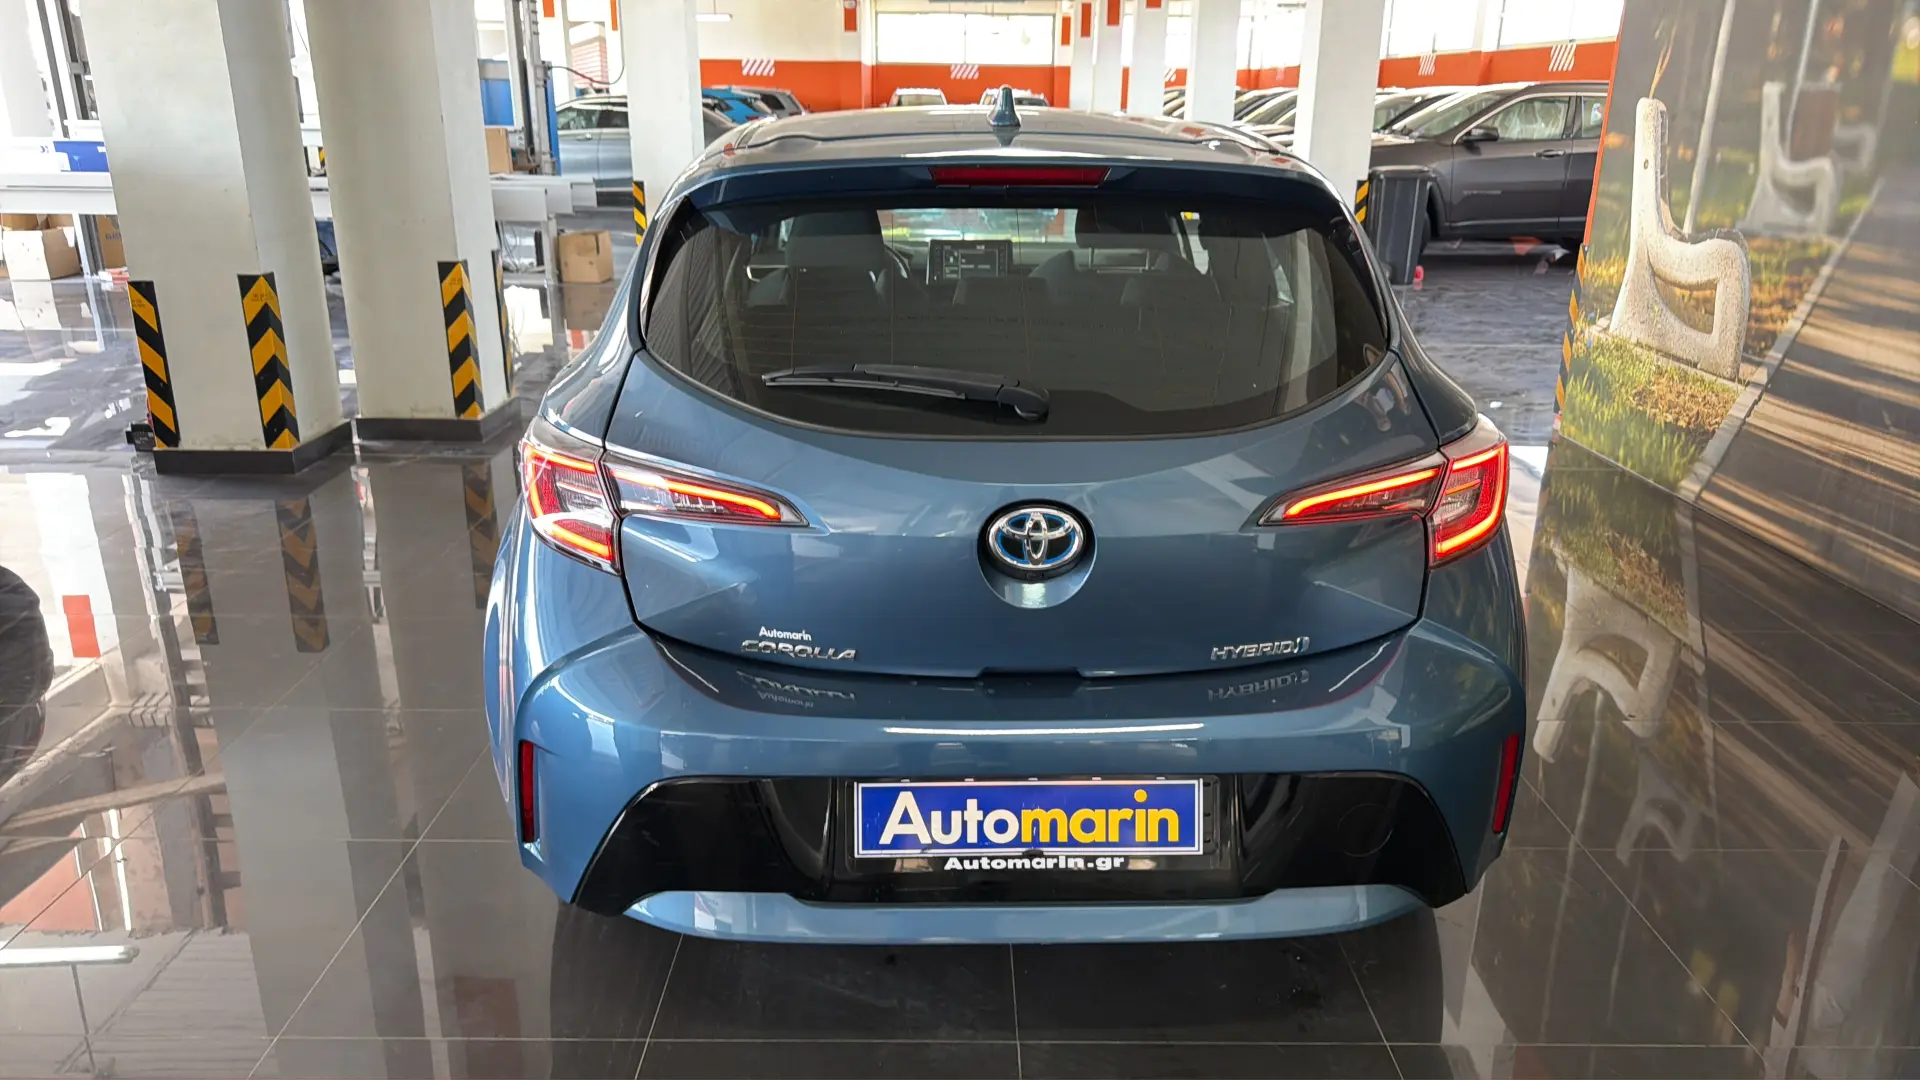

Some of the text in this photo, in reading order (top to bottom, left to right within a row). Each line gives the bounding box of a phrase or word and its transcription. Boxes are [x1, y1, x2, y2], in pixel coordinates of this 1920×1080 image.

[758, 626, 812, 641] Automarin
[741, 639, 857, 660] COROLLA
[1210, 640, 1295, 661] HYBRID
[879, 789, 1179, 845] Automarin
[943, 855, 1125, 871] Automarin.gr
